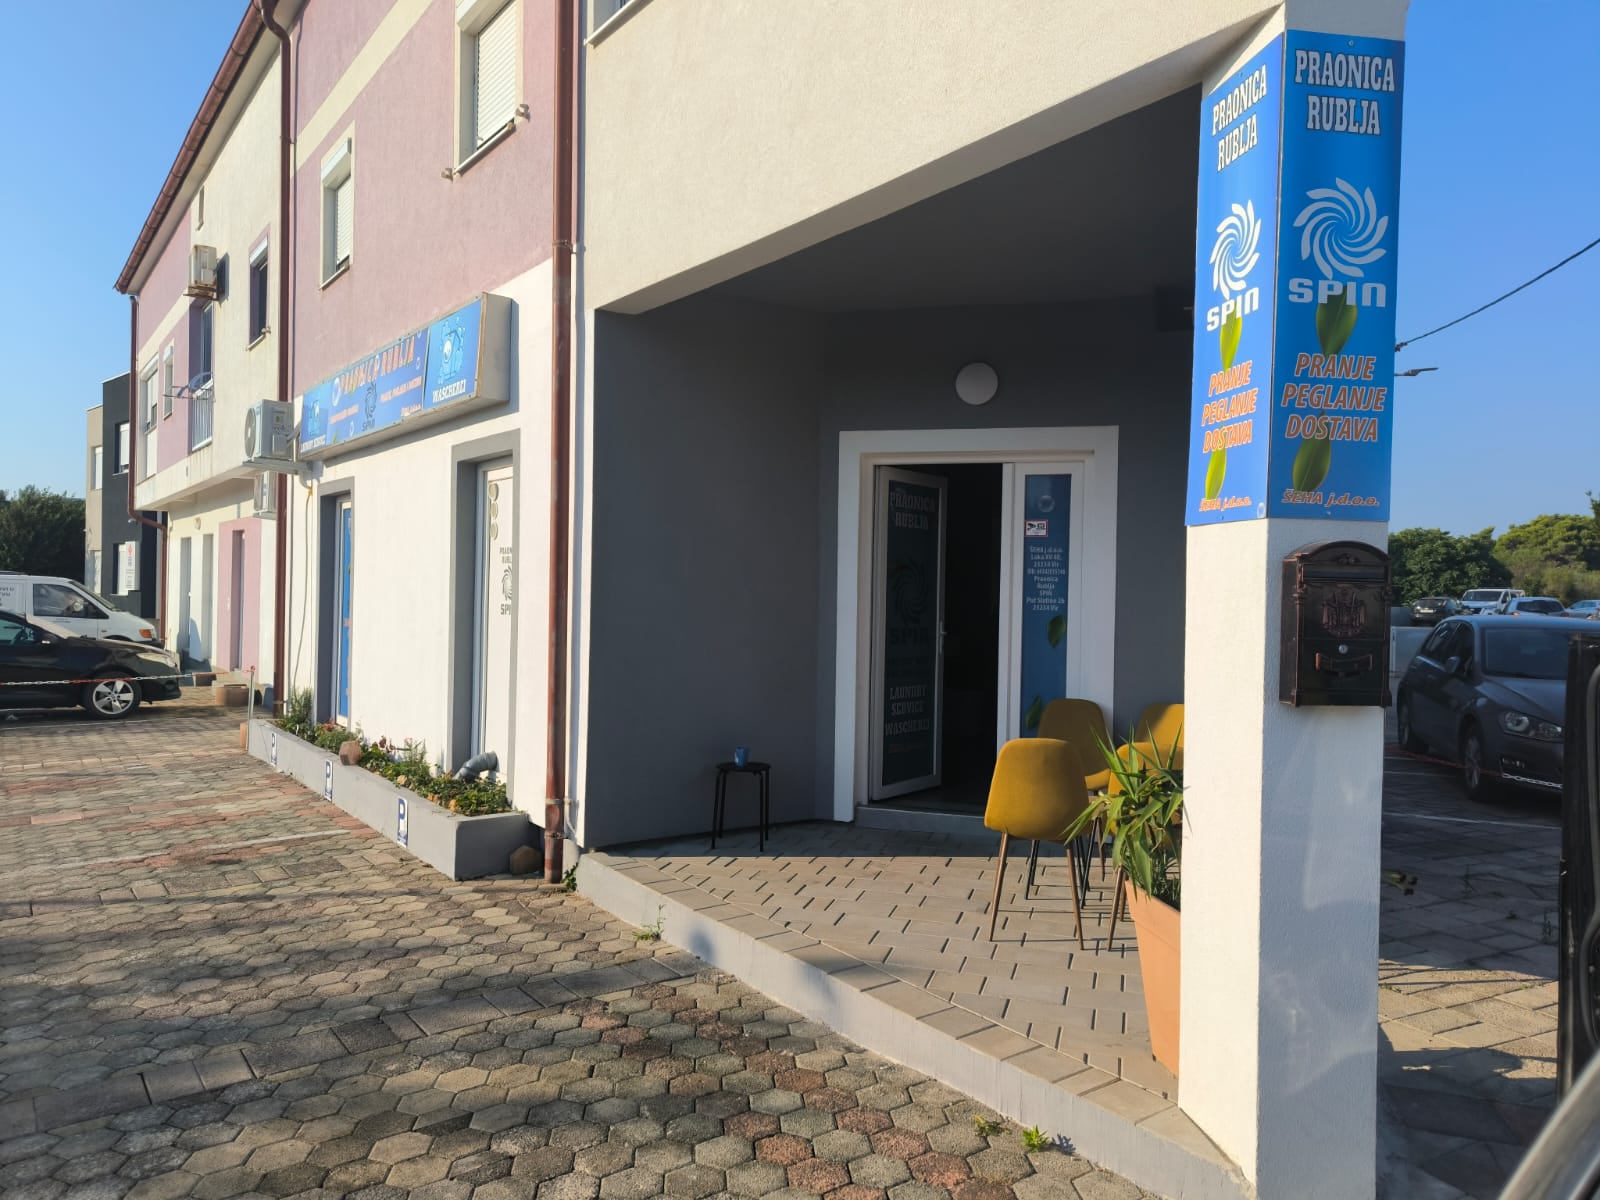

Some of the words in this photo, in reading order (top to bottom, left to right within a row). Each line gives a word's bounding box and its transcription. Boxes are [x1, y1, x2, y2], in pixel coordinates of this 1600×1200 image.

[1294, 49, 1396, 92] PRAONICA
[1212, 64, 1267, 136] PRAONICA
[1306, 95, 1381, 135] RUBLJA
[1217, 114, 1258, 172] RUBLJA
[1208, 360, 1253, 397] PRANJE
[1294, 352, 1377, 380] PRANJE
[1201, 388, 1259, 426] PEGLANJE
[1281, 383, 1388, 411] PEGLANJE
[1203, 419, 1253, 454] DOSTAVA
[1284, 415, 1379, 442] DOSTAVA
